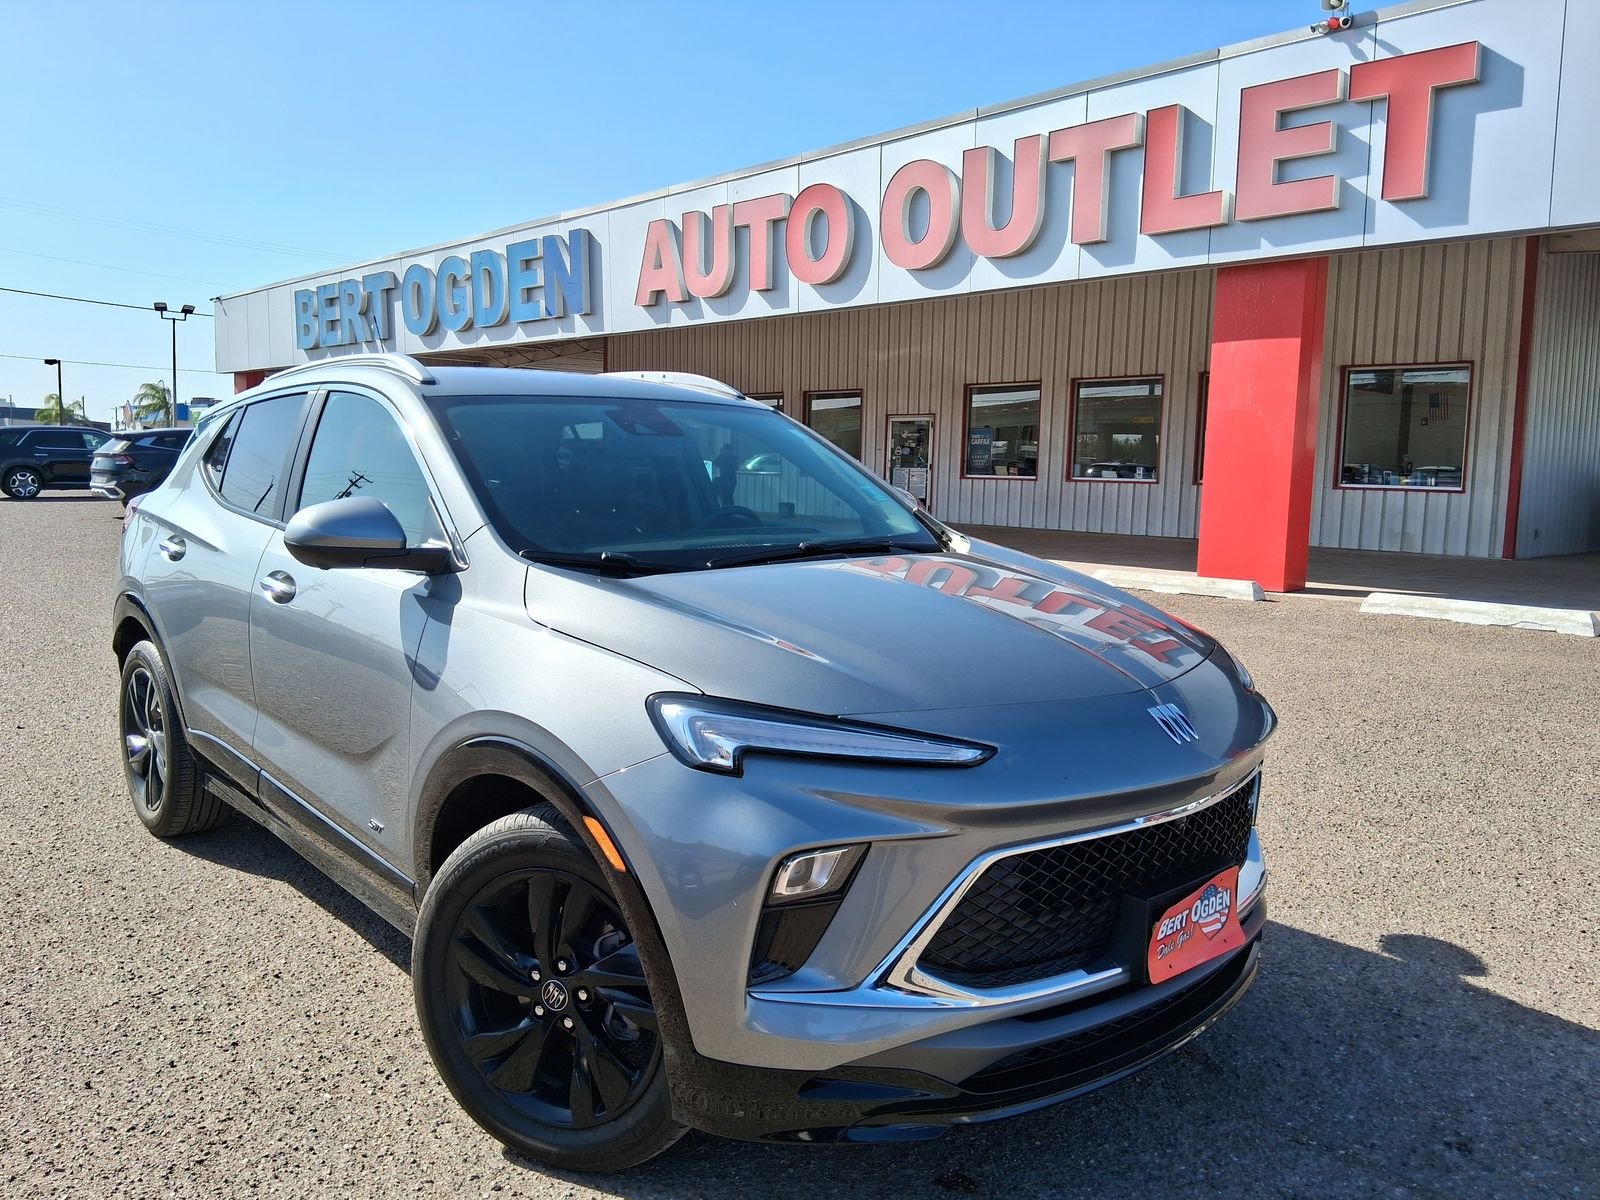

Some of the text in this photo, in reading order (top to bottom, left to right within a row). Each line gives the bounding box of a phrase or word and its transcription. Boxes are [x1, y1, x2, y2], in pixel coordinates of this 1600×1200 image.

[294, 41, 1481, 350] BERT OGDEN AUTO OUTLET
[1157, 888, 1231, 940] BERT OGDEN
[1156, 925, 1195, 960] Dale Gas!
